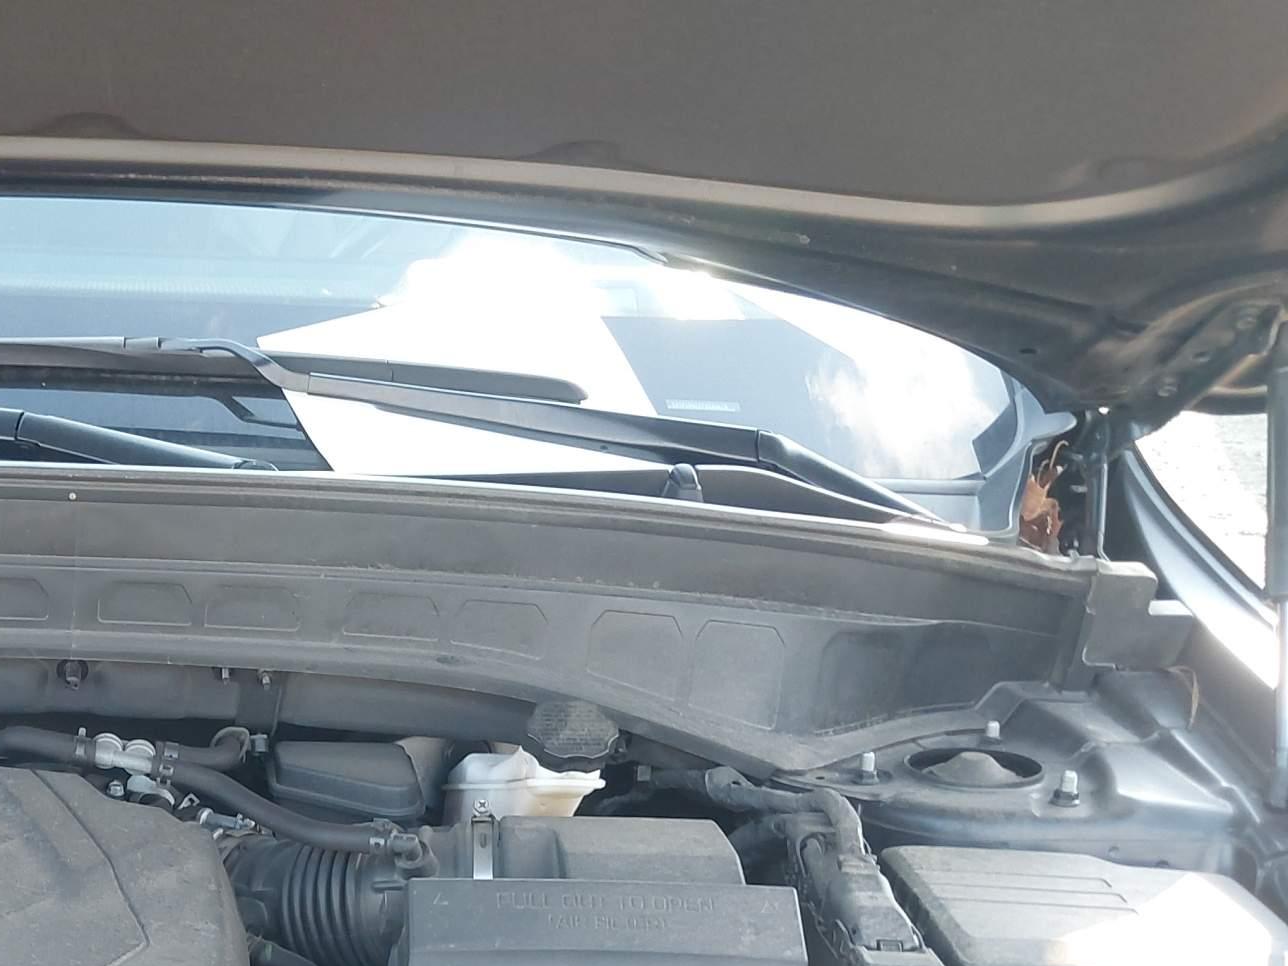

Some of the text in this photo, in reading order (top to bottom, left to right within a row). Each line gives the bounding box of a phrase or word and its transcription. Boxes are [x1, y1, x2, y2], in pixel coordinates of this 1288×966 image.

[495, 892, 716, 913] PULL OUT TO OPEN
